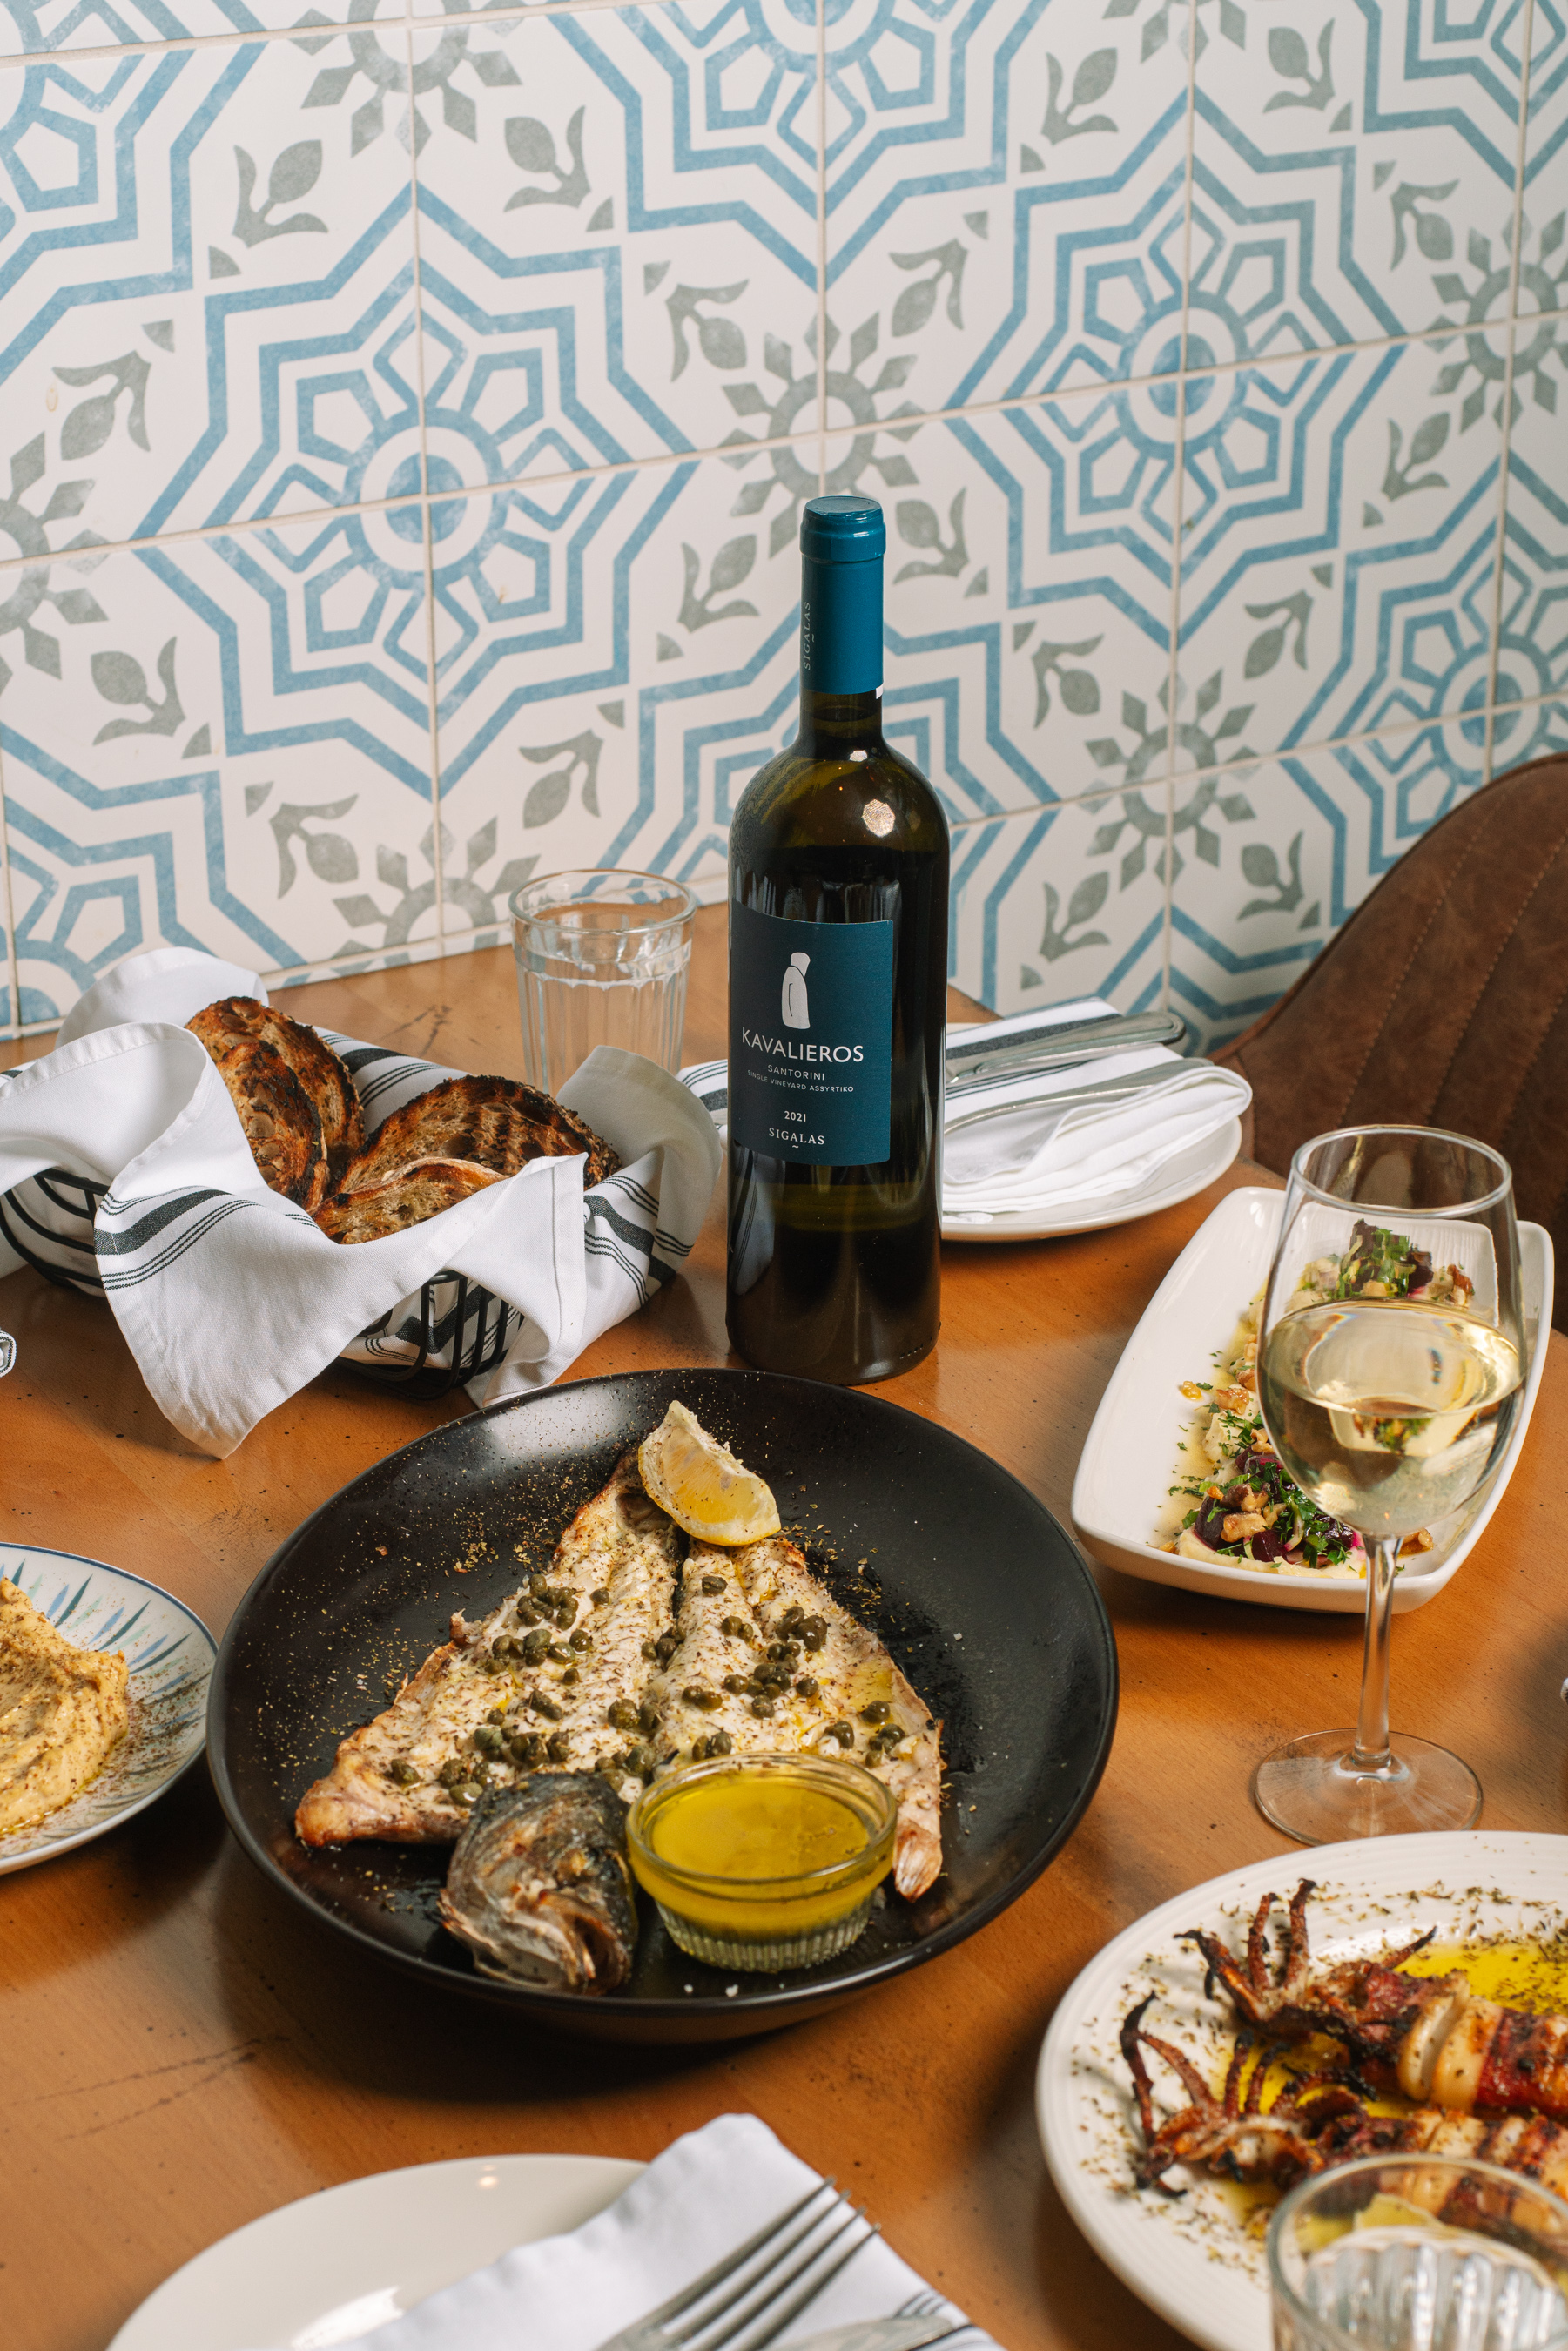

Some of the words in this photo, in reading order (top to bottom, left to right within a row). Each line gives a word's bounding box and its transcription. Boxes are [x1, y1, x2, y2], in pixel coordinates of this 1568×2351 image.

[742, 1027, 864, 1063] KAVALIEROS
[747, 1069, 768, 1083] SINGLE
[770, 1077, 807, 1090] VINEYARD
[767, 1064, 825, 1081] SANTORINI
[784, 1110, 806, 1122] 2021
[768, 1127, 825, 1145] SIGALAS
